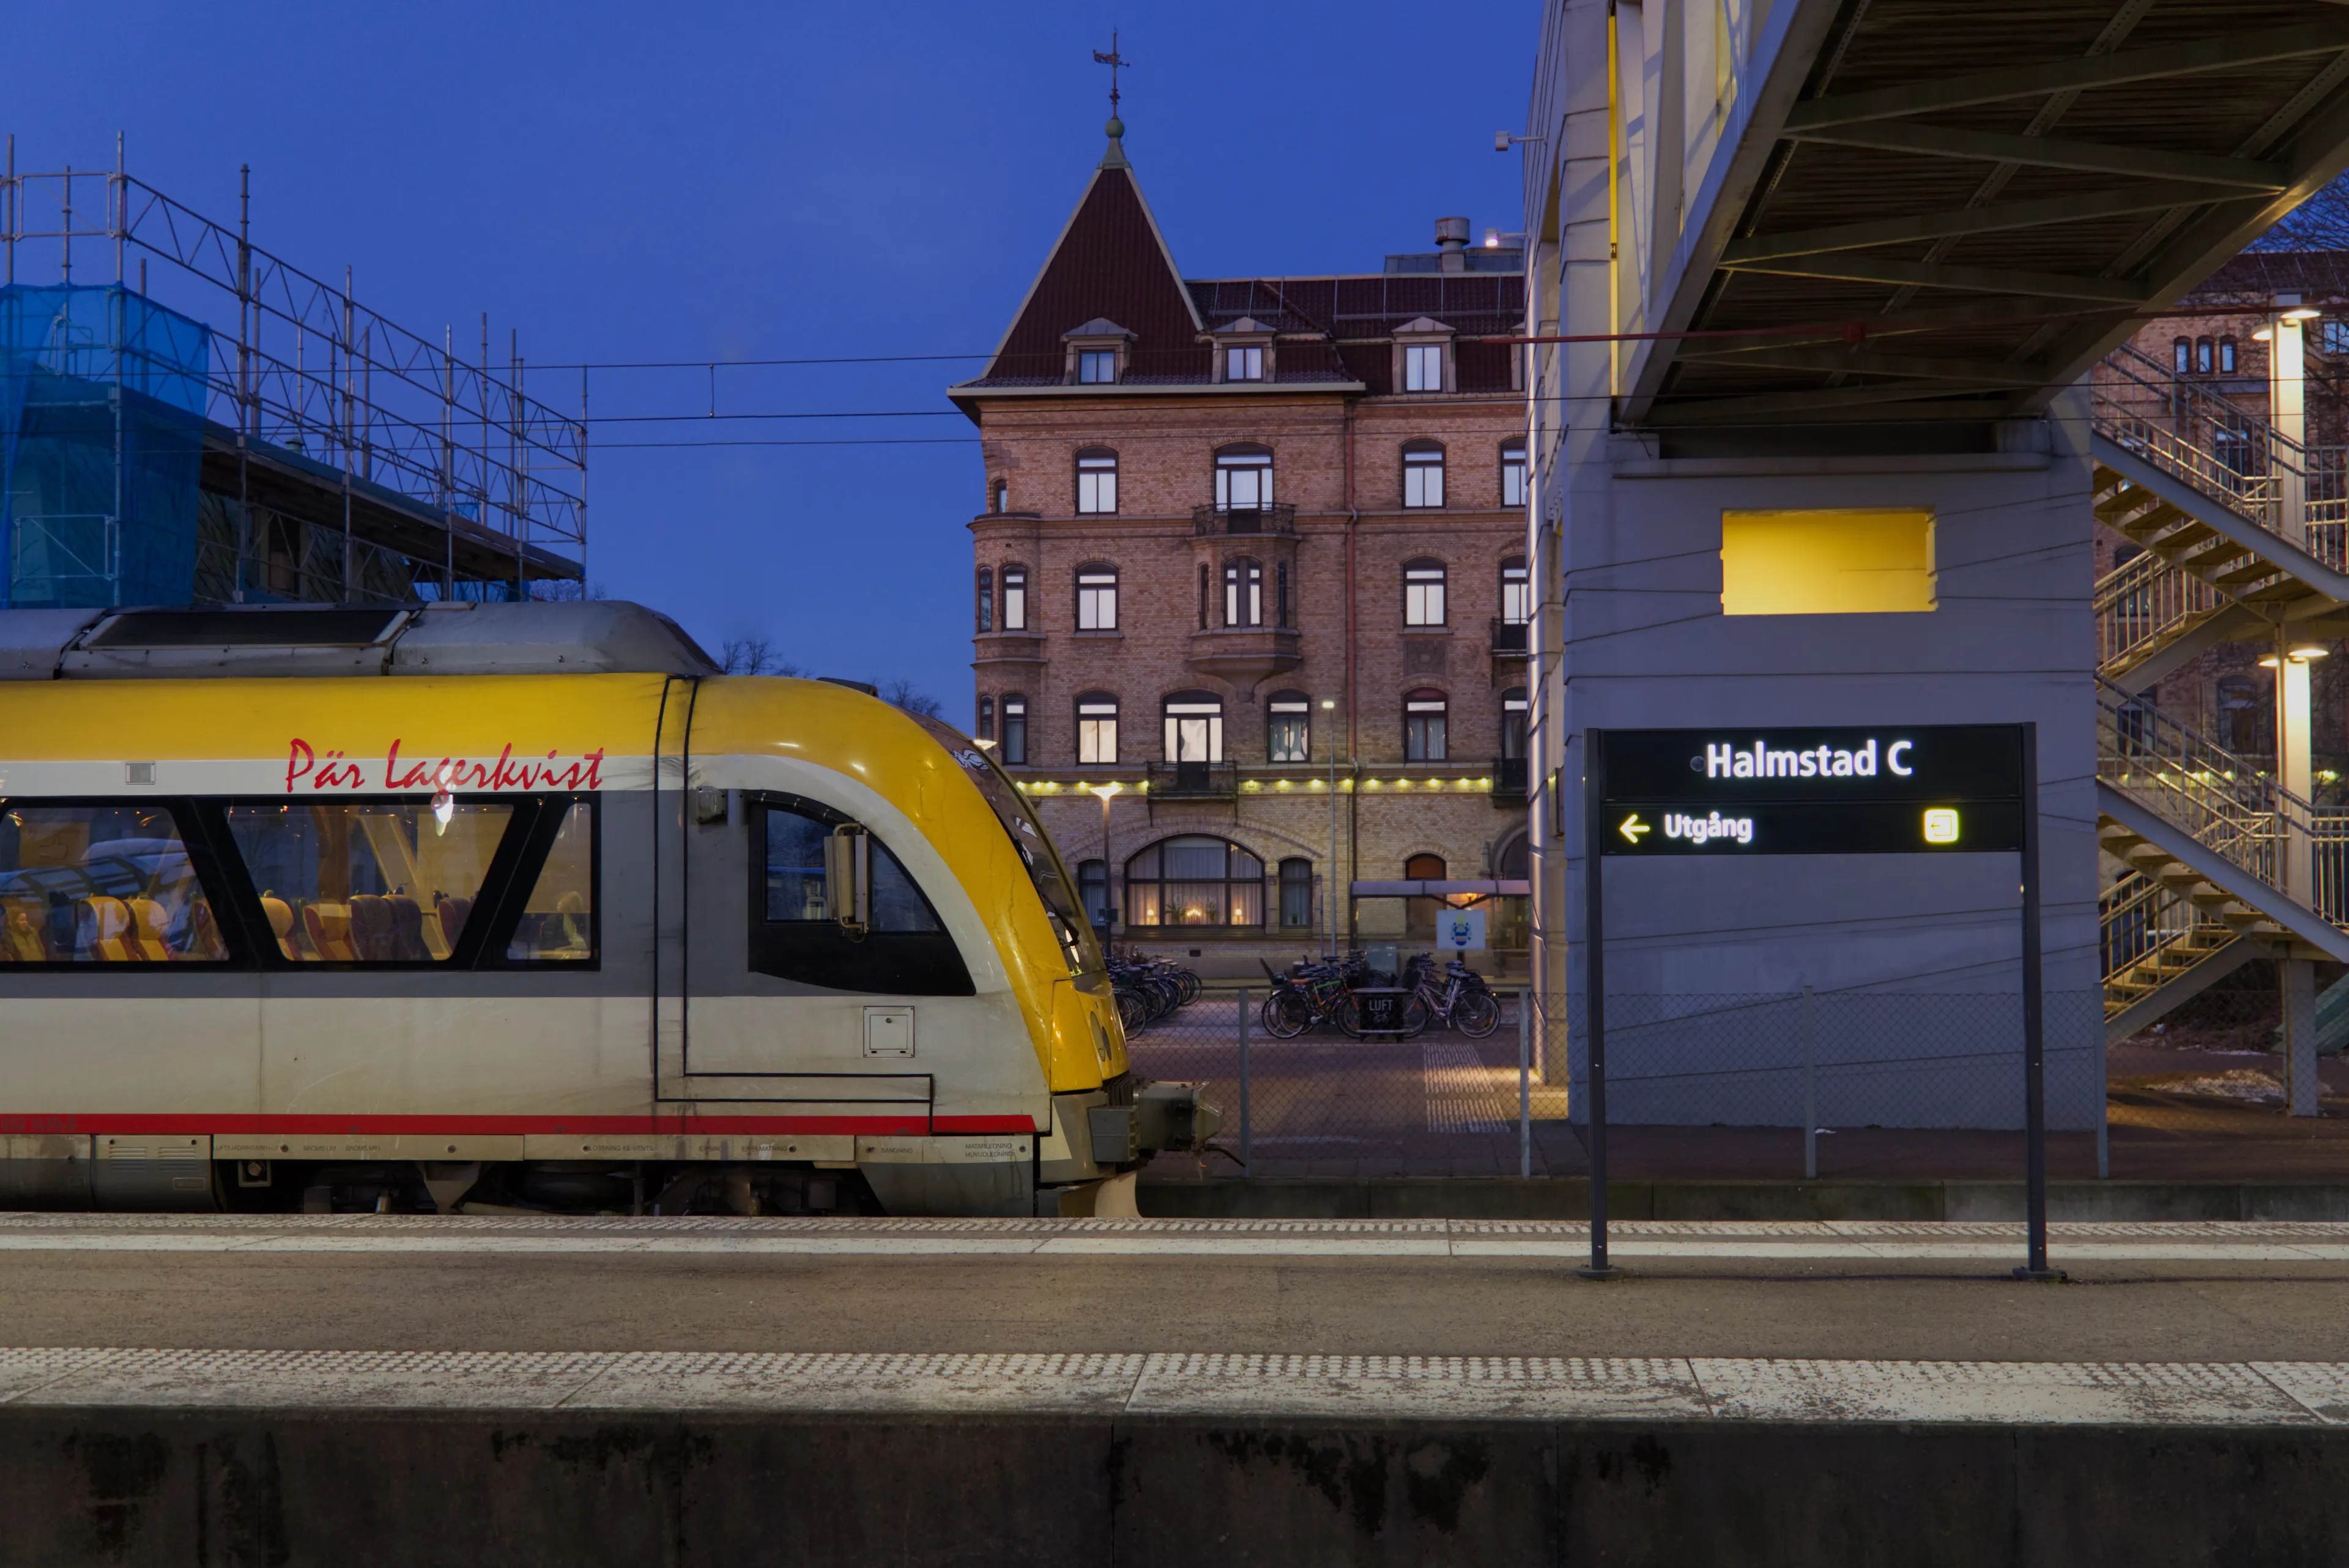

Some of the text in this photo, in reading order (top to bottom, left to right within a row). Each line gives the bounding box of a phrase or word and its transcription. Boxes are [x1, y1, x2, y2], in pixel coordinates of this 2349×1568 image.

[285, 738, 604, 811] Pär Lagerkvist
[1707, 738, 1913, 778] Halmstad C
[1664, 811, 1753, 844] Utgång
[1368, 999, 1393, 1011] LUFT
